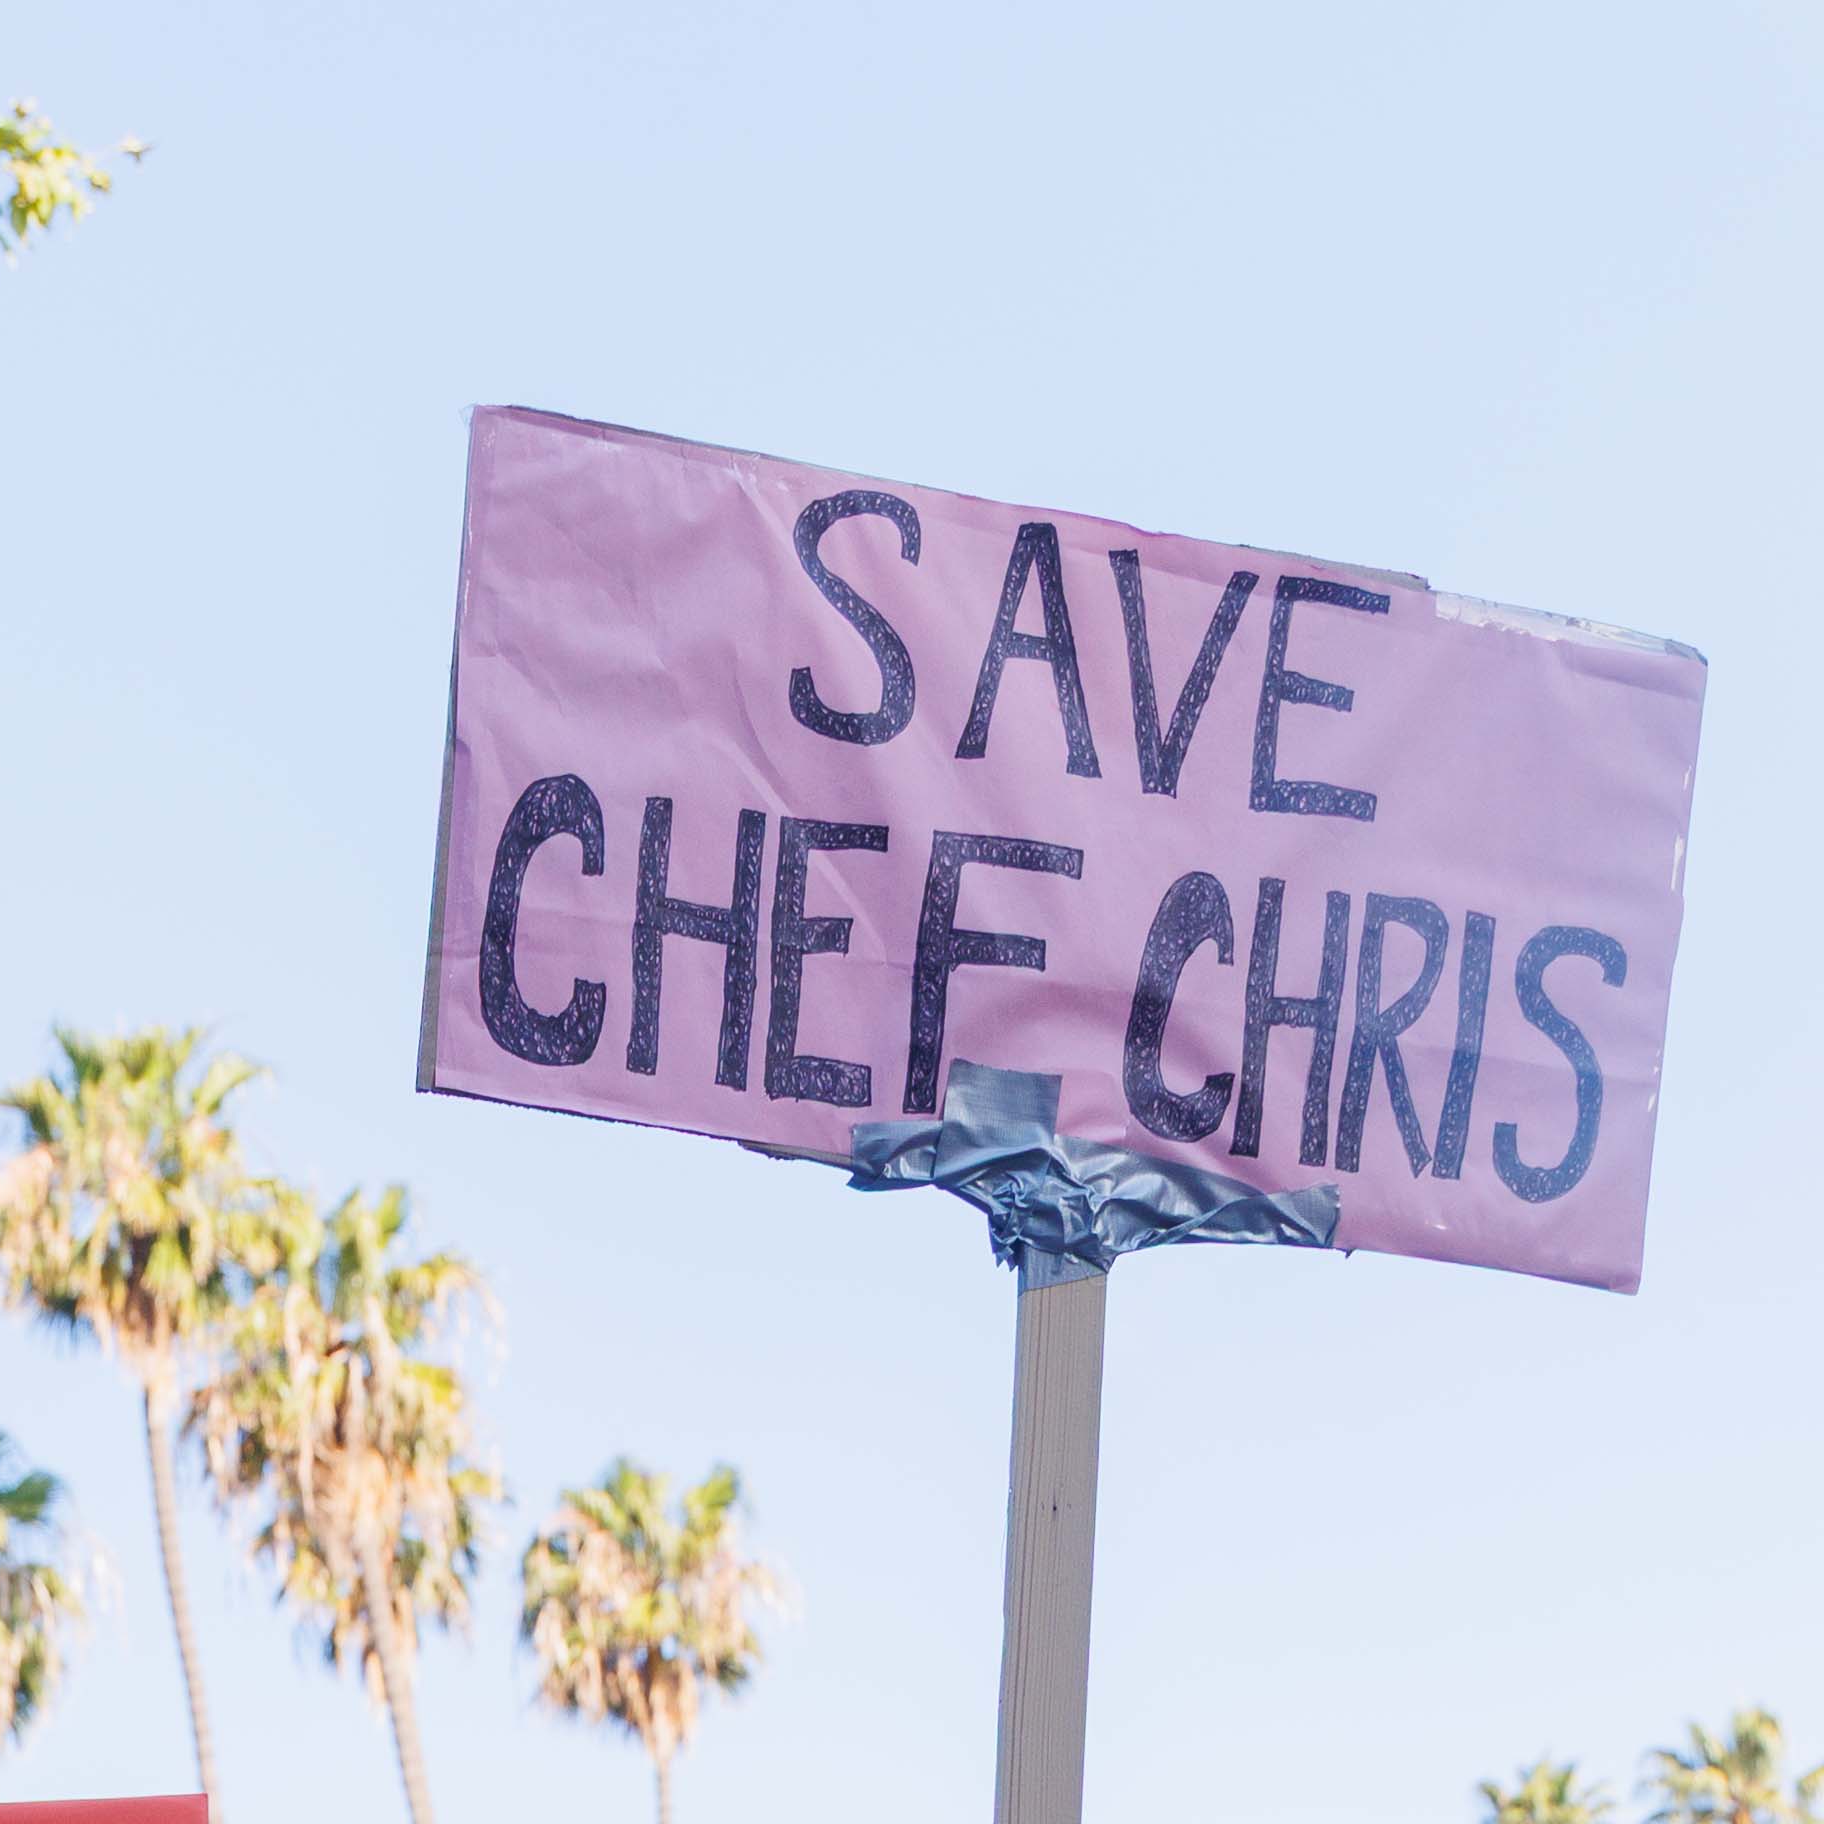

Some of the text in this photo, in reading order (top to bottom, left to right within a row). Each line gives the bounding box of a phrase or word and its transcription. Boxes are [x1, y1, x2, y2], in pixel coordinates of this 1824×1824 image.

[788, 488, 1391, 822] SAVE
[478, 773, 1628, 1203] CHEF CHRIS
